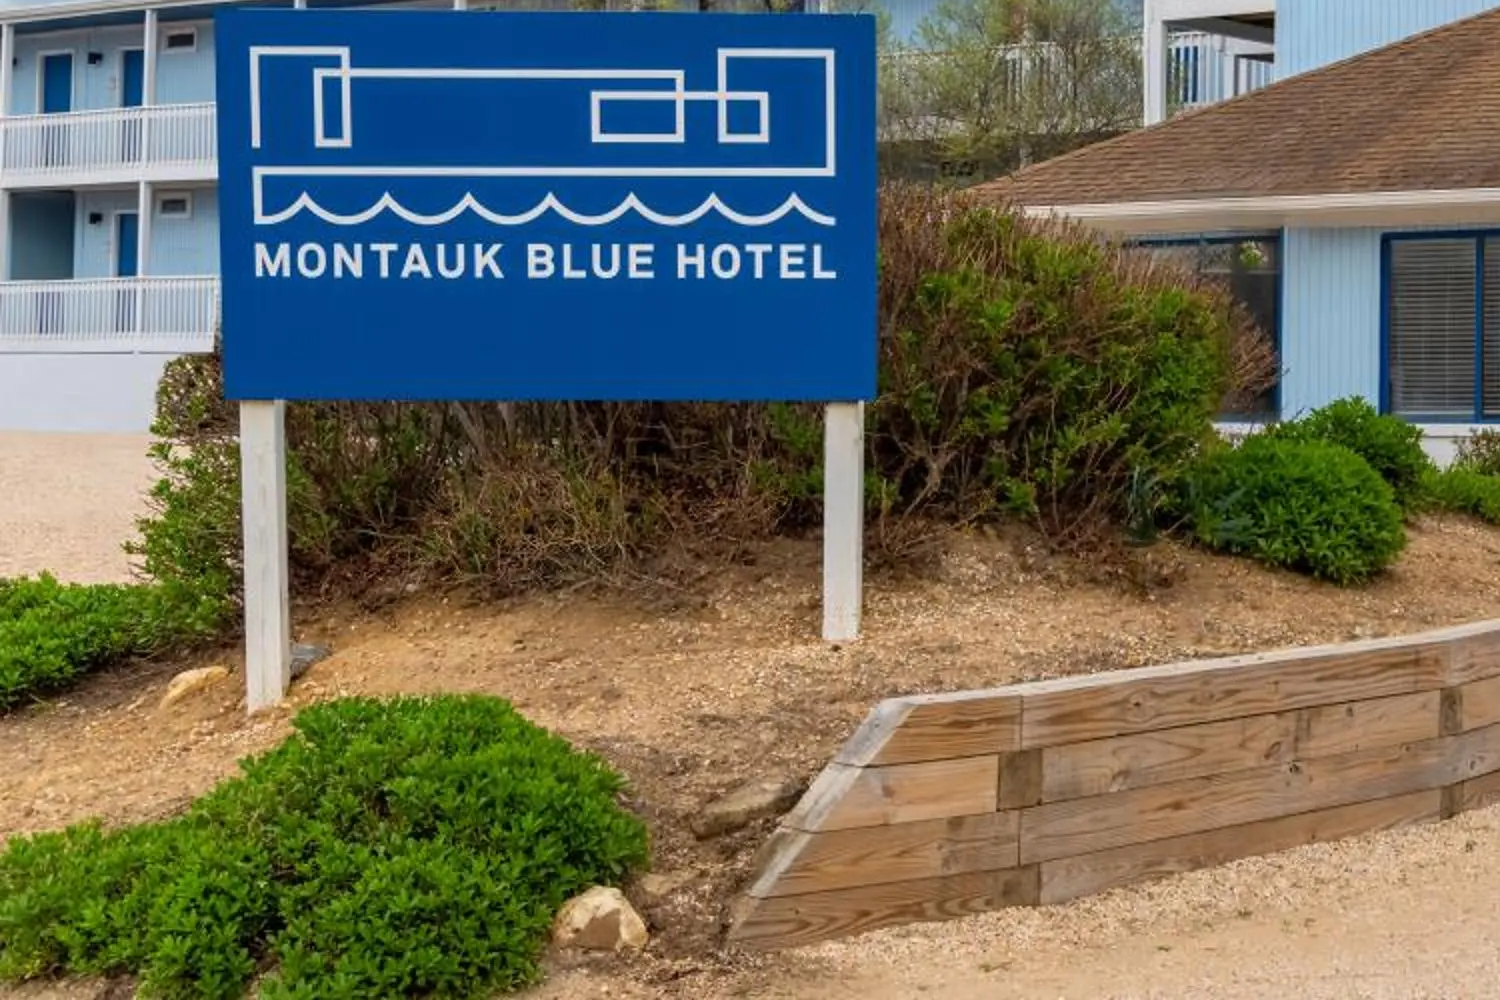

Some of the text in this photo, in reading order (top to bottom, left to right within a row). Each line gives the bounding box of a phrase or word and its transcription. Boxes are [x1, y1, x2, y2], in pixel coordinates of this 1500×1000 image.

[254, 243, 837, 279] MONTAUK BLUE HOTEL
